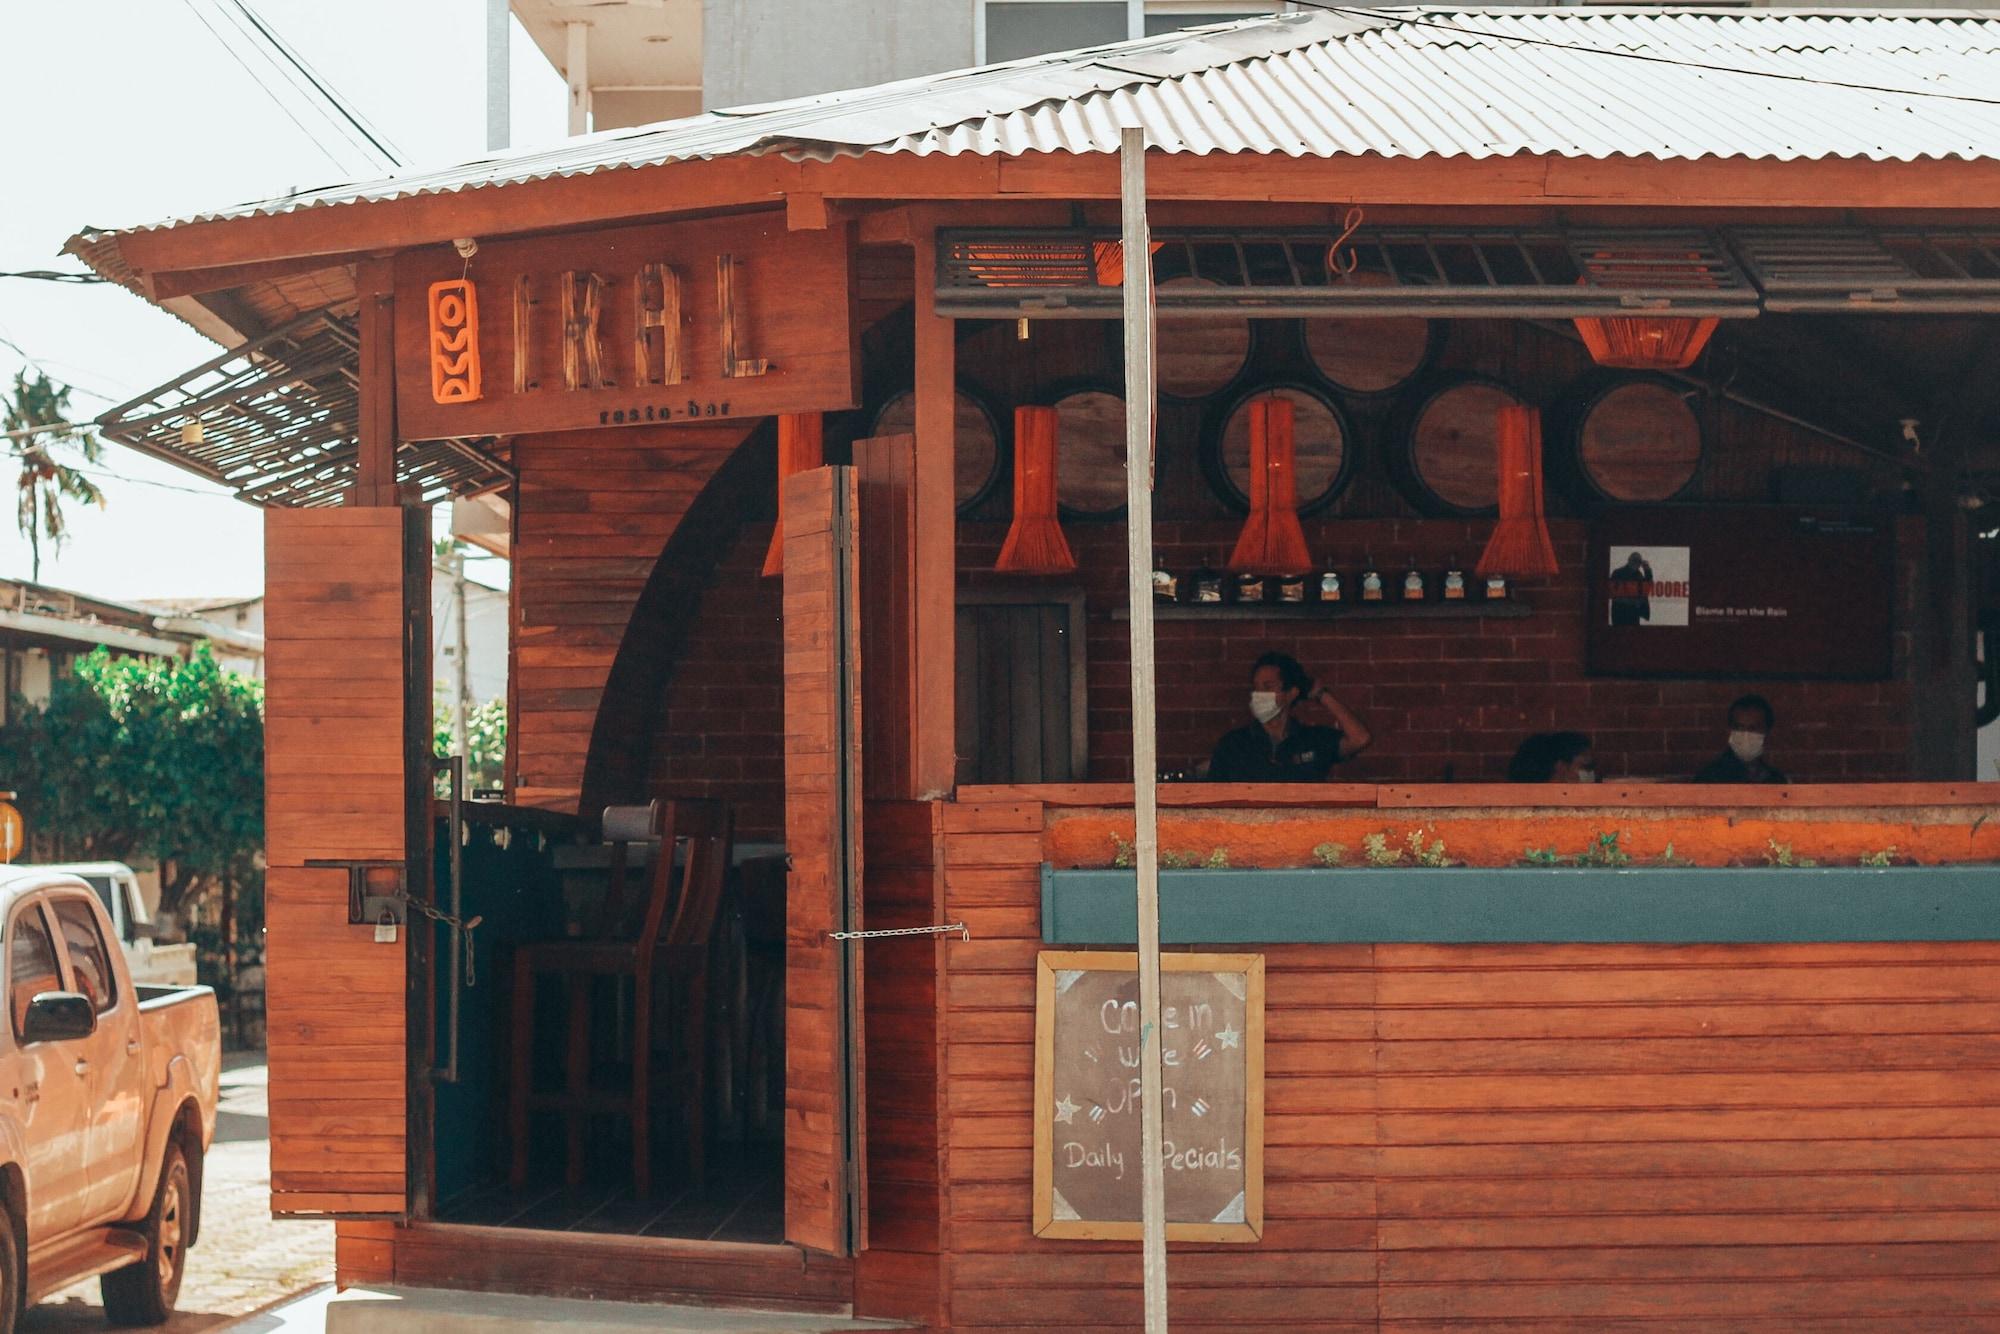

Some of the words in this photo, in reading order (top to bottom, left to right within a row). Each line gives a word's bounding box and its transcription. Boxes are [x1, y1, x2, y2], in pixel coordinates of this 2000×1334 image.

[513, 253, 768, 393] IKAL
[600, 400, 730, 425] resto-bar
[1063, 1142, 1125, 1180] Daily
